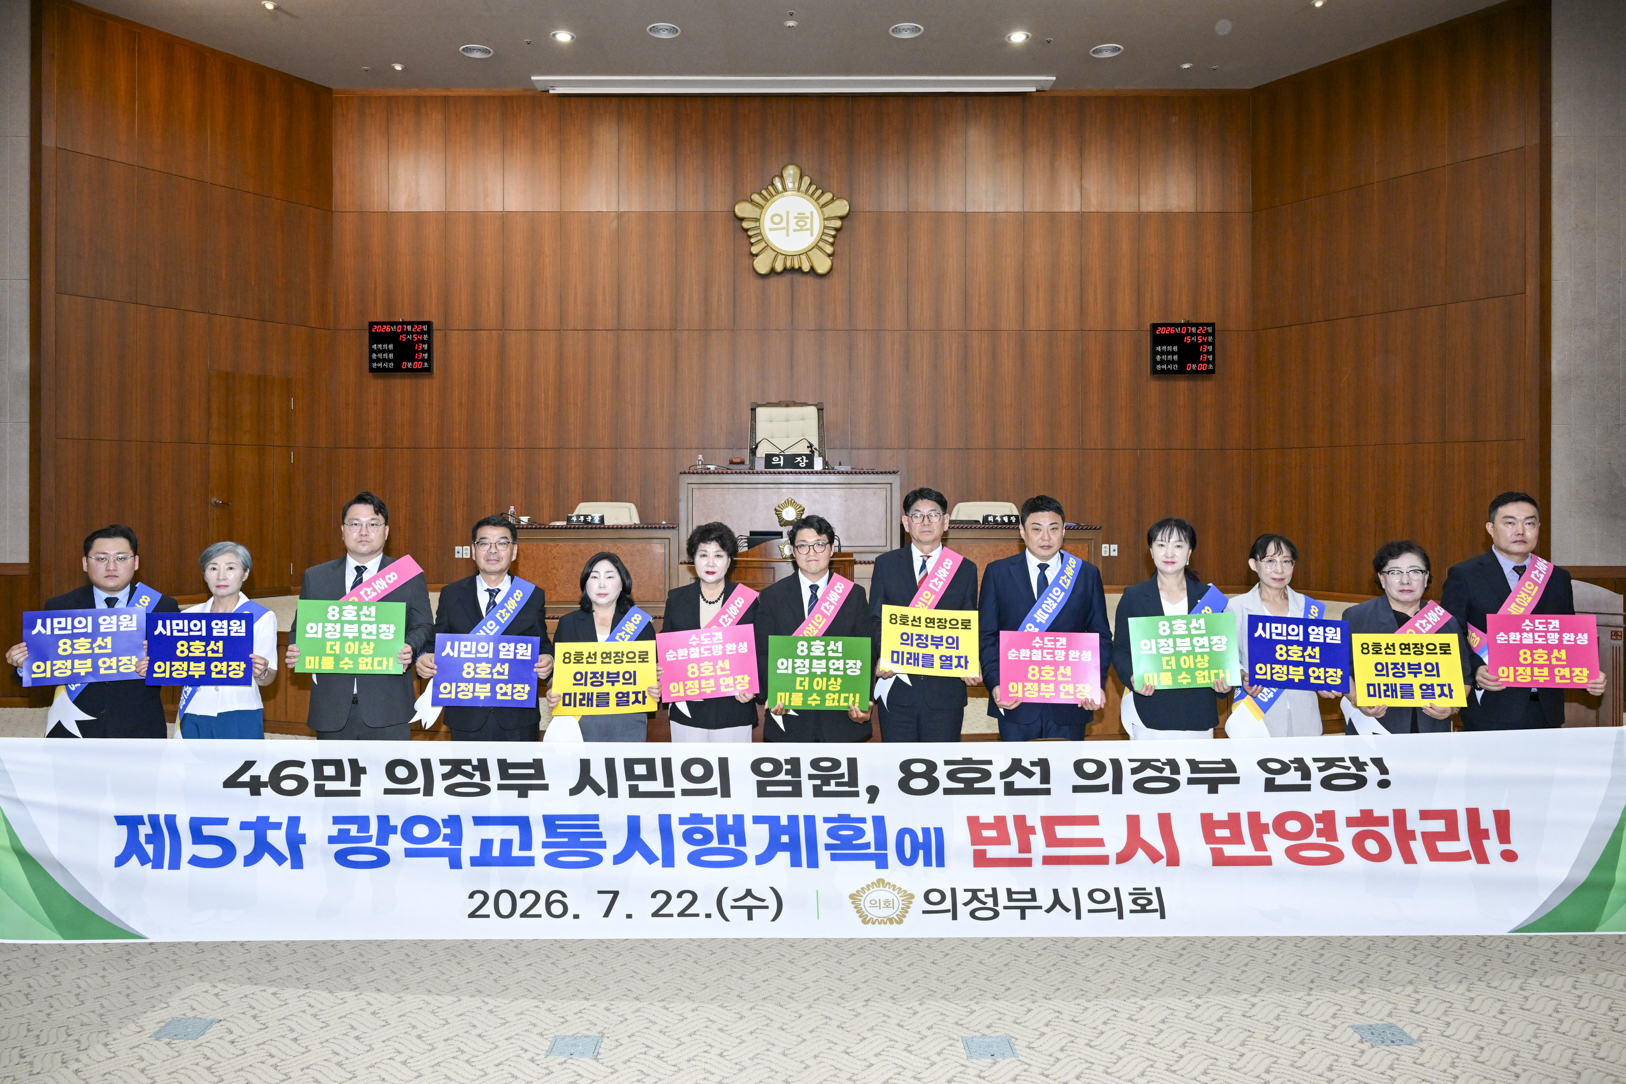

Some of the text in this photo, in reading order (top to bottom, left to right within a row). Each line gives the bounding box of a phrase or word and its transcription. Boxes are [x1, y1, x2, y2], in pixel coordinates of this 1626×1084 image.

[769, 211, 813, 237] 의회
[929, 558, 953, 592] 8호선
[1059, 557, 1076, 589] 8호선
[1531, 557, 1548, 584] 호선
[496, 590, 523, 623] 8호선
[821, 582, 844, 616] 8호선
[1034, 587, 1065, 623] 의정부
[327, 605, 376, 621] 8호선
[32, 614, 137, 635] 시민의 염원
[154, 620, 246, 636] 시민의 염원
[889, 614, 971, 630] 8호선 연장으로
[1158, 618, 1206, 635] 8호선
[1521, 619, 1560, 631] 수도권
[305, 623, 396, 640] 의정부연장
[689, 632, 723, 645] 수도권
[1254, 622, 1341, 644] 시민의 염원
[1496, 632, 1588, 644] 순환철도망 완성
[58, 636, 112, 655] 8호선
[176, 640, 223, 657] 8호선
[326, 641, 375, 655] 더 이상
[796, 640, 842, 656] 8호선
[900, 632, 959, 650] 의정부의
[1032, 637, 1066, 648] 수도권
[1140, 635, 1227, 654] 의정부연장
[1361, 642, 1451, 655] 8호선 연장으로
[442, 641, 532, 659] 시민의 염원
[562, 651, 649, 664] 8호선 연장으로
[666, 642, 748, 661] 순환철도망 완성
[1008, 649, 1092, 661] 순환철도망 완성
[1275, 644, 1320, 663] 8호선
[1519, 649, 1566, 664] 8호선
[32, 656, 138, 678] 의정부 연장
[305, 656, 393, 670] 미룰 수 없다!
[687, 659, 730, 678] 8호선
[777, 658, 862, 675] 의정부연장
[891, 650, 969, 670] 미래를 열자
[1162, 655, 1209, 669] 더 이상
[153, 662, 246, 678] 의정부 연장
[462, 662, 509, 679] 8호선
[1028, 665, 1071, 681] 8호선
[1144, 669, 1230, 685] 미룰 수 없다!
[1255, 663, 1343, 685] 의정부 연장
[1374, 662, 1440, 678] 의정부의
[1498, 666, 1589, 683] 의정부 연장
[573, 671, 636, 687] 의정부의
[670, 675, 750, 697] 의정부 연장
[796, 677, 842, 691] 더 이상
[439, 682, 530, 700] 의정부 연장
[562, 691, 647, 707] 미래를 열자
[777, 692, 859, 706] 미룰 수 없다!
[1008, 682, 1092, 699] 의정부 연장
[1367, 683, 1453, 699] 미래를 열자
[223, 756, 1391, 804] 46만 의정부 시민의 염원, 8호선 의정부 연장!
[114, 807, 1519, 870] 제5차 광역교통시행계획에 반드시 반영하라!
[467, 886, 783, 922] 2026. 7. 22.(수)
[869, 899, 894, 910] 의회
[921, 887, 1166, 921] 의정부시의회
